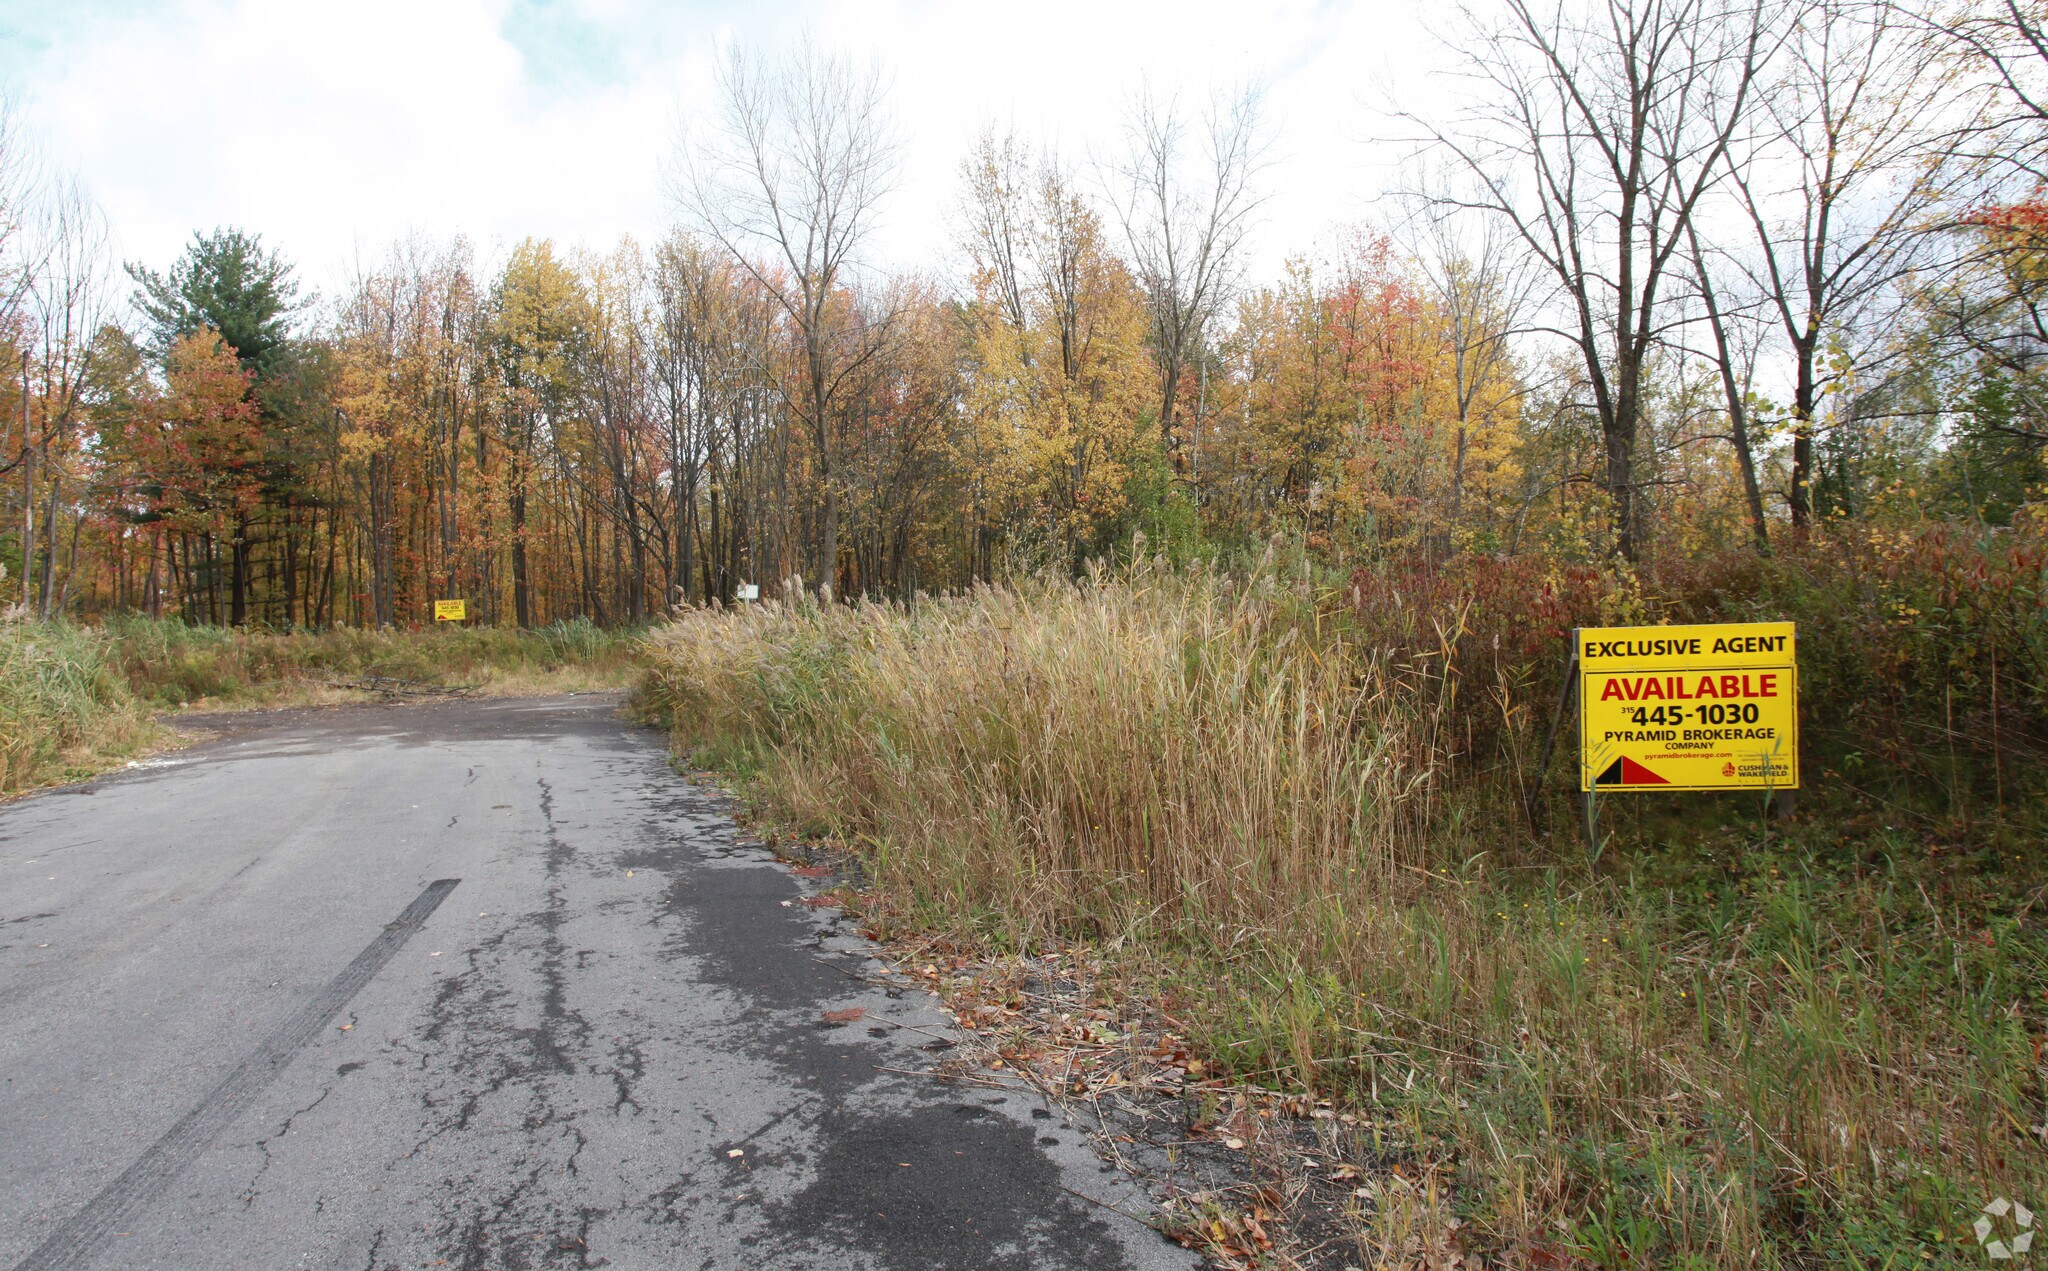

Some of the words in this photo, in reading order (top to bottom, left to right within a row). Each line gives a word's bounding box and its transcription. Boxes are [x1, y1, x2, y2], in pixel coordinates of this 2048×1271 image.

[1585, 639, 1701, 658] EXCLUSIVE
[1712, 636, 1787, 654] AGENT
[1600, 674, 1777, 701] AVAILABLE
[1632, 704, 1759, 726] 445-1030
[1604, 730, 1676, 742] PYRAMID
[1683, 728, 1775, 740] BROKERAGE
[1665, 742, 1715, 750] COMPANY
[1644, 752, 1732, 761] pyramidbrokerage.com
